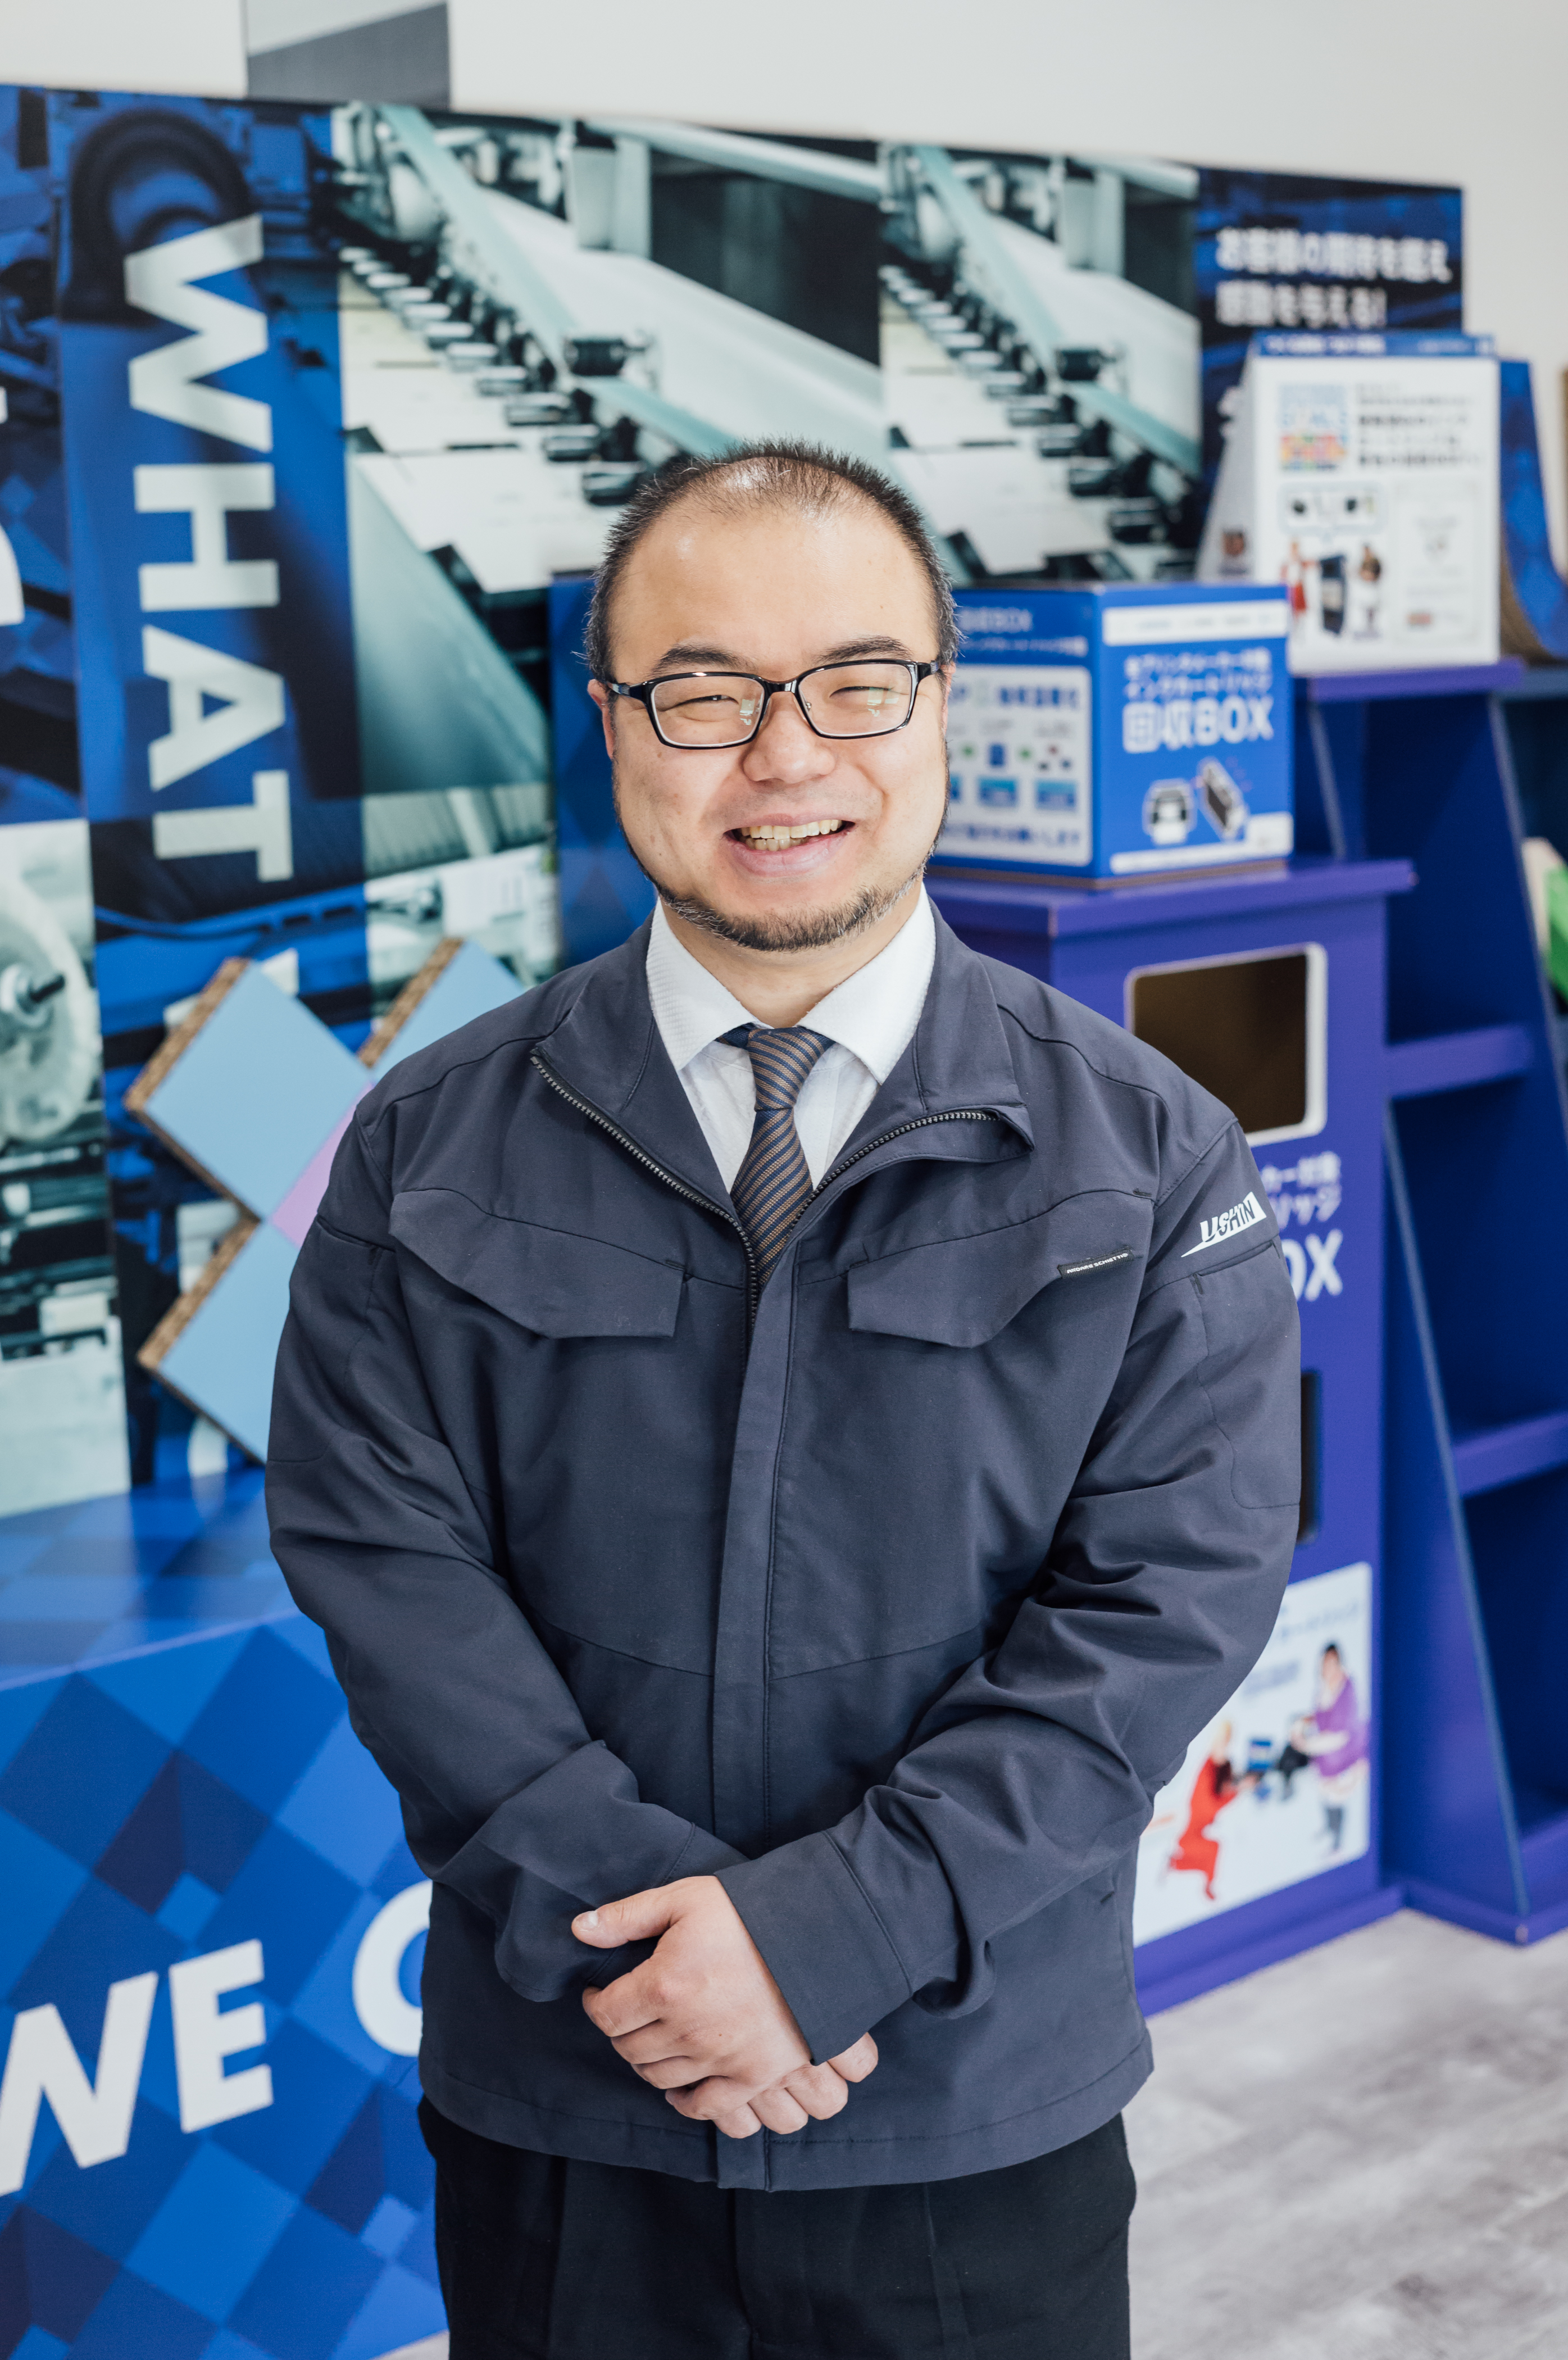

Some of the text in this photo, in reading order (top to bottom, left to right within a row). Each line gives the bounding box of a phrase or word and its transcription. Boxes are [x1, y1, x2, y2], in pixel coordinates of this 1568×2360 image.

[125, 214, 293, 882] WHAT
[1122, 696, 1274, 754] 回収BOX
[1199, 1197, 1257, 1243] USHIN
[1066, 1263, 1094, 1274] ANDARE
[0, 1937, 274, 2197] WE
